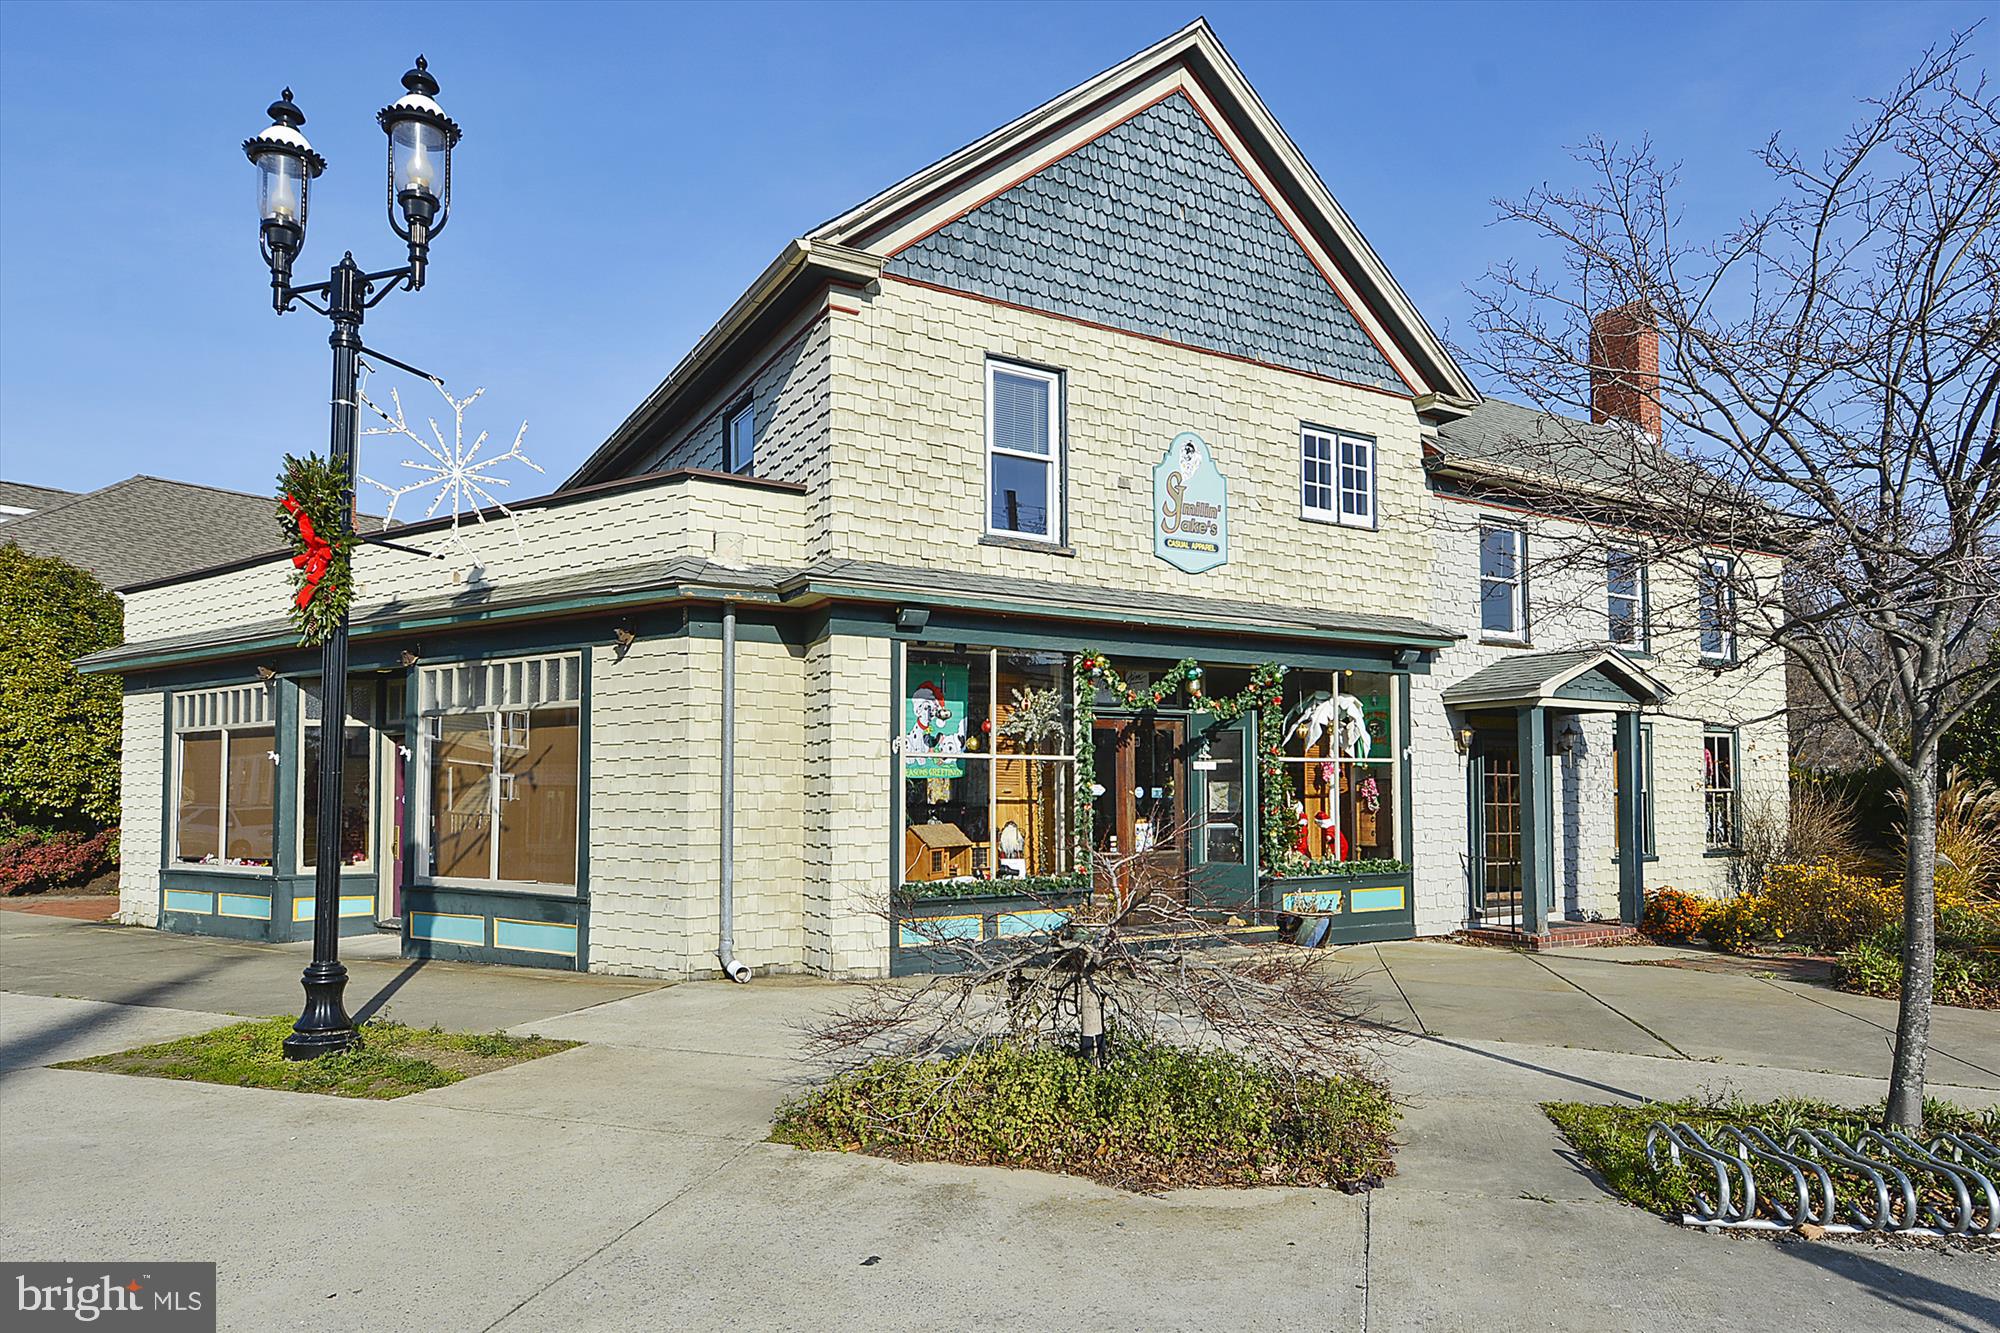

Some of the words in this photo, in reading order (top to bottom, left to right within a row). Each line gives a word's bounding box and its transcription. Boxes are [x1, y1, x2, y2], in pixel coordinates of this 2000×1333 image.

[1161, 485, 1217, 536] Jake's
[1167, 539, 1189, 549] CASUAL
[1191, 541, 1217, 552] APPAREL
[905, 768, 929, 777] EASONS
